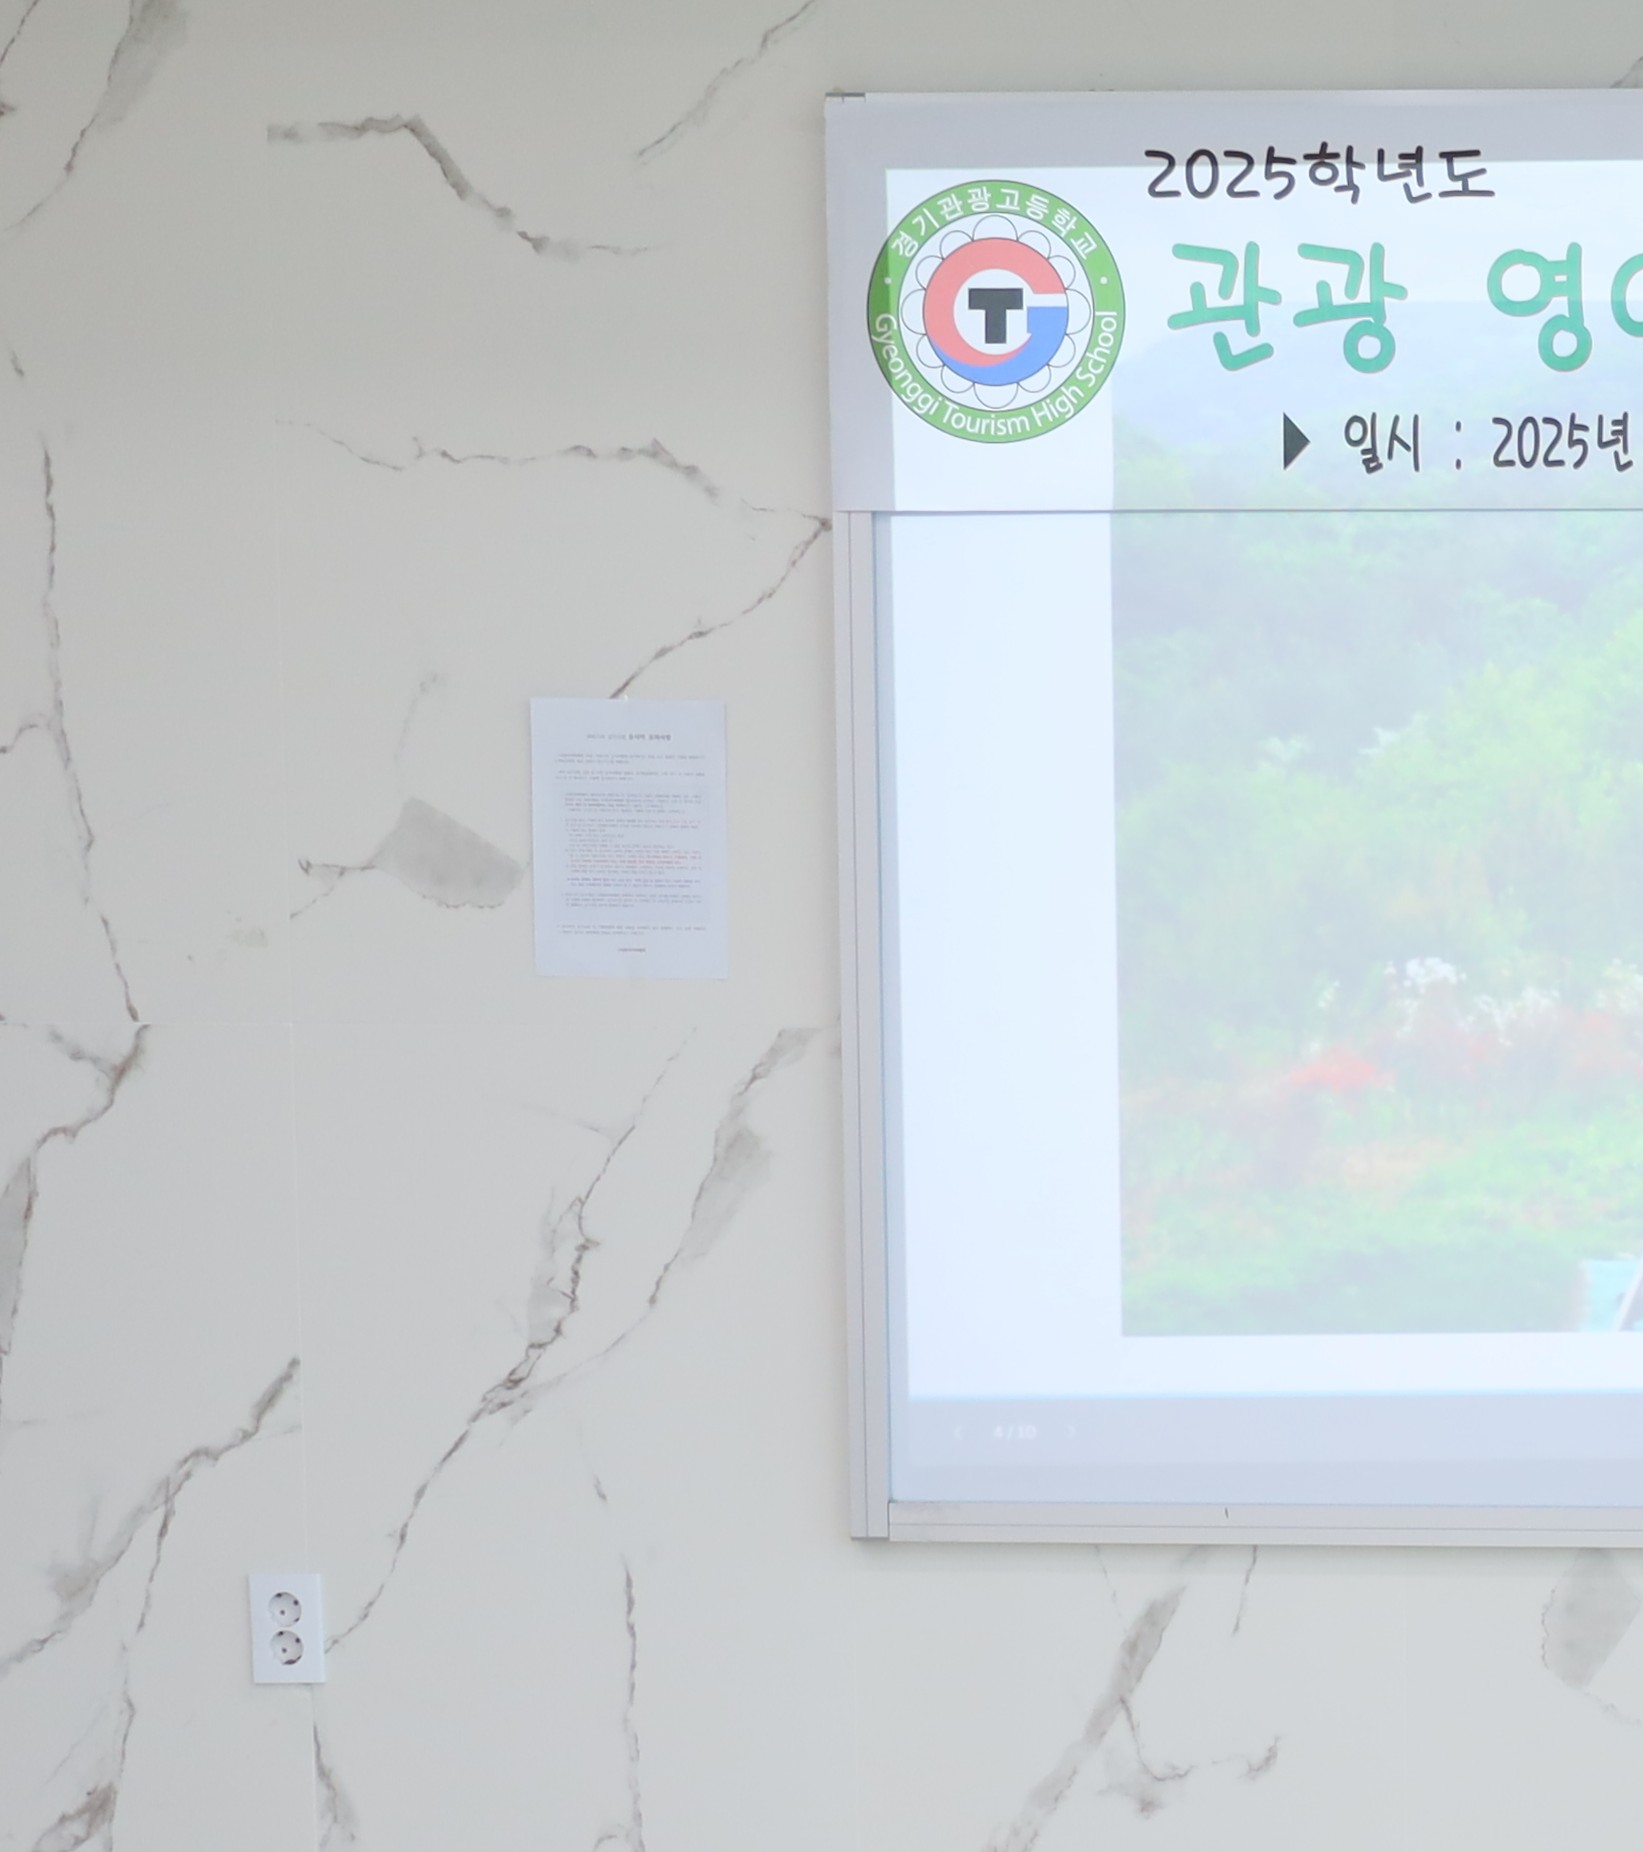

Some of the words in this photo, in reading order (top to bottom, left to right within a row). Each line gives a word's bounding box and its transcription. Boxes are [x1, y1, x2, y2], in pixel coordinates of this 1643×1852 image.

[1144, 140, 1496, 205] 2025학년도
[891, 186, 1098, 260] 경기관광고등학교
[1167, 240, 1408, 374] 관광
[871, 313, 942, 416] Gyeonggi
[941, 401, 1030, 436] Tourism
[1033, 384, 1085, 427] High
[1075, 311, 1118, 388] School
[1343, 411, 1420, 475] 일시
[1491, 411, 1634, 473] 2025년
